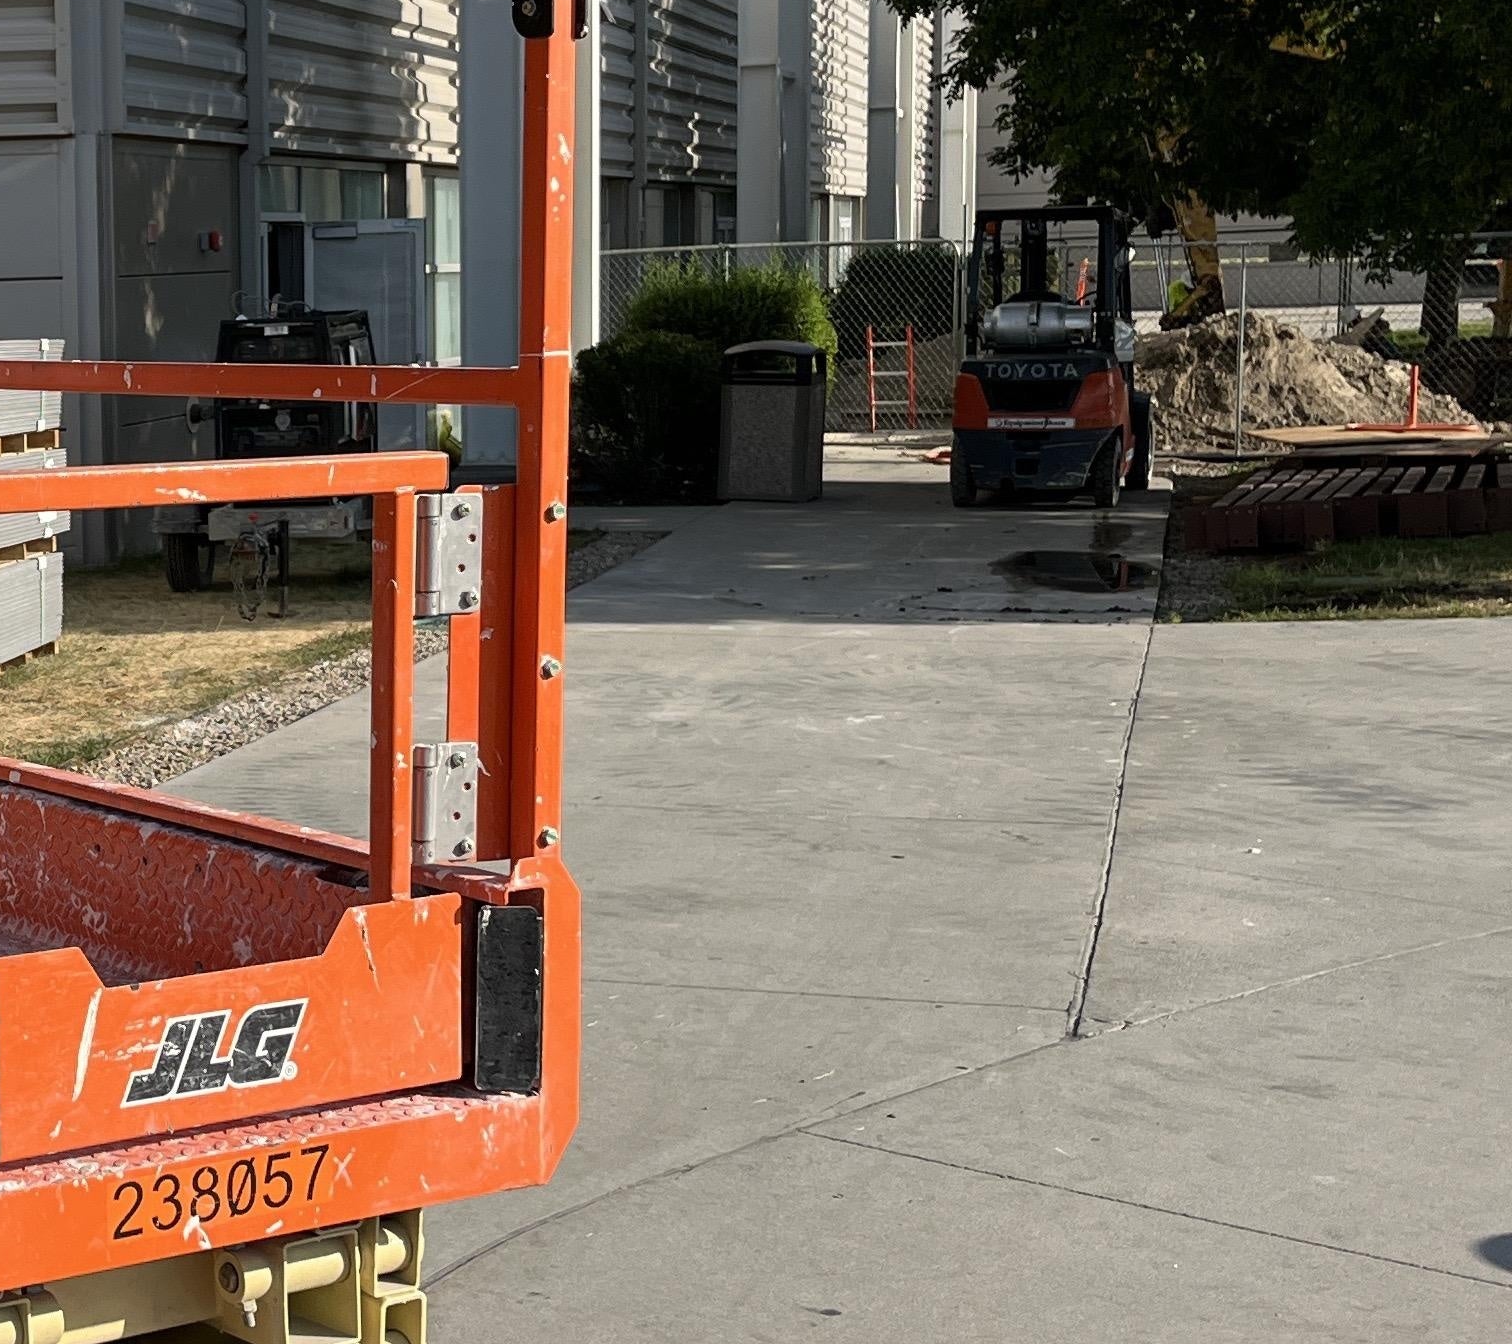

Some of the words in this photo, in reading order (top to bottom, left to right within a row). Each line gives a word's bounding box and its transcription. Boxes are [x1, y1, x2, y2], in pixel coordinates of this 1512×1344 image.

[984, 363, 1078, 379] TOYOTA
[120, 998, 309, 1109] JLG
[112, 1144, 330, 1241] 238057
